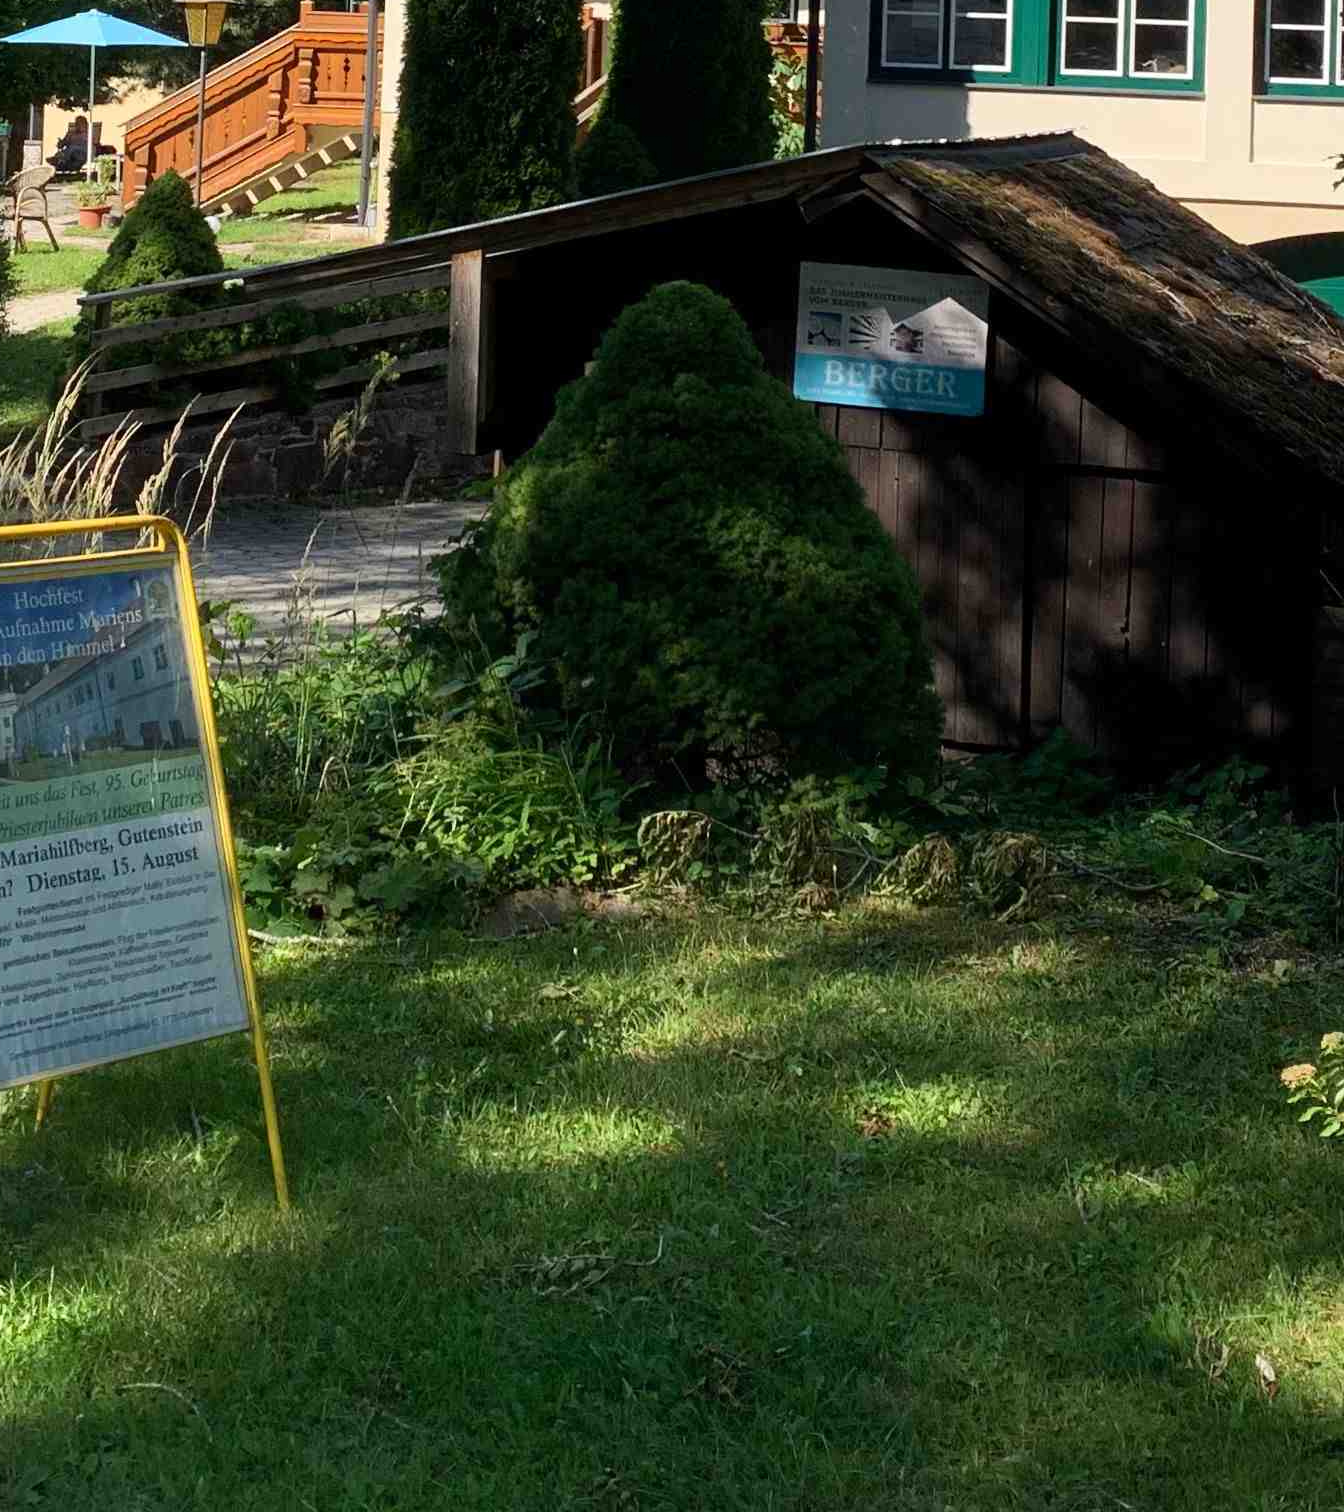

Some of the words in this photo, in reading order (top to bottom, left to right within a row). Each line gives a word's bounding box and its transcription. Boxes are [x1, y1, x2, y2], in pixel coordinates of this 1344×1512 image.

[823, 359, 959, 398] BERGER
[14, 586, 85, 610] Hochfest
[80, 608, 144, 632] Mariens
[16, 645, 48, 665] den
[51, 635, 115, 661] Himmel
[16, 791, 40, 808] uns
[43, 784, 67, 802] das
[105, 774, 126, 792] 95.
[160, 791, 205, 810] Patres
[0, 837, 114, 870] Mariahilfberg,
[118, 817, 204, 847] Gutenstein
[26, 867, 106, 893] Dienstag,
[112, 857, 137, 877] 15.
[142, 847, 200, 871] August
